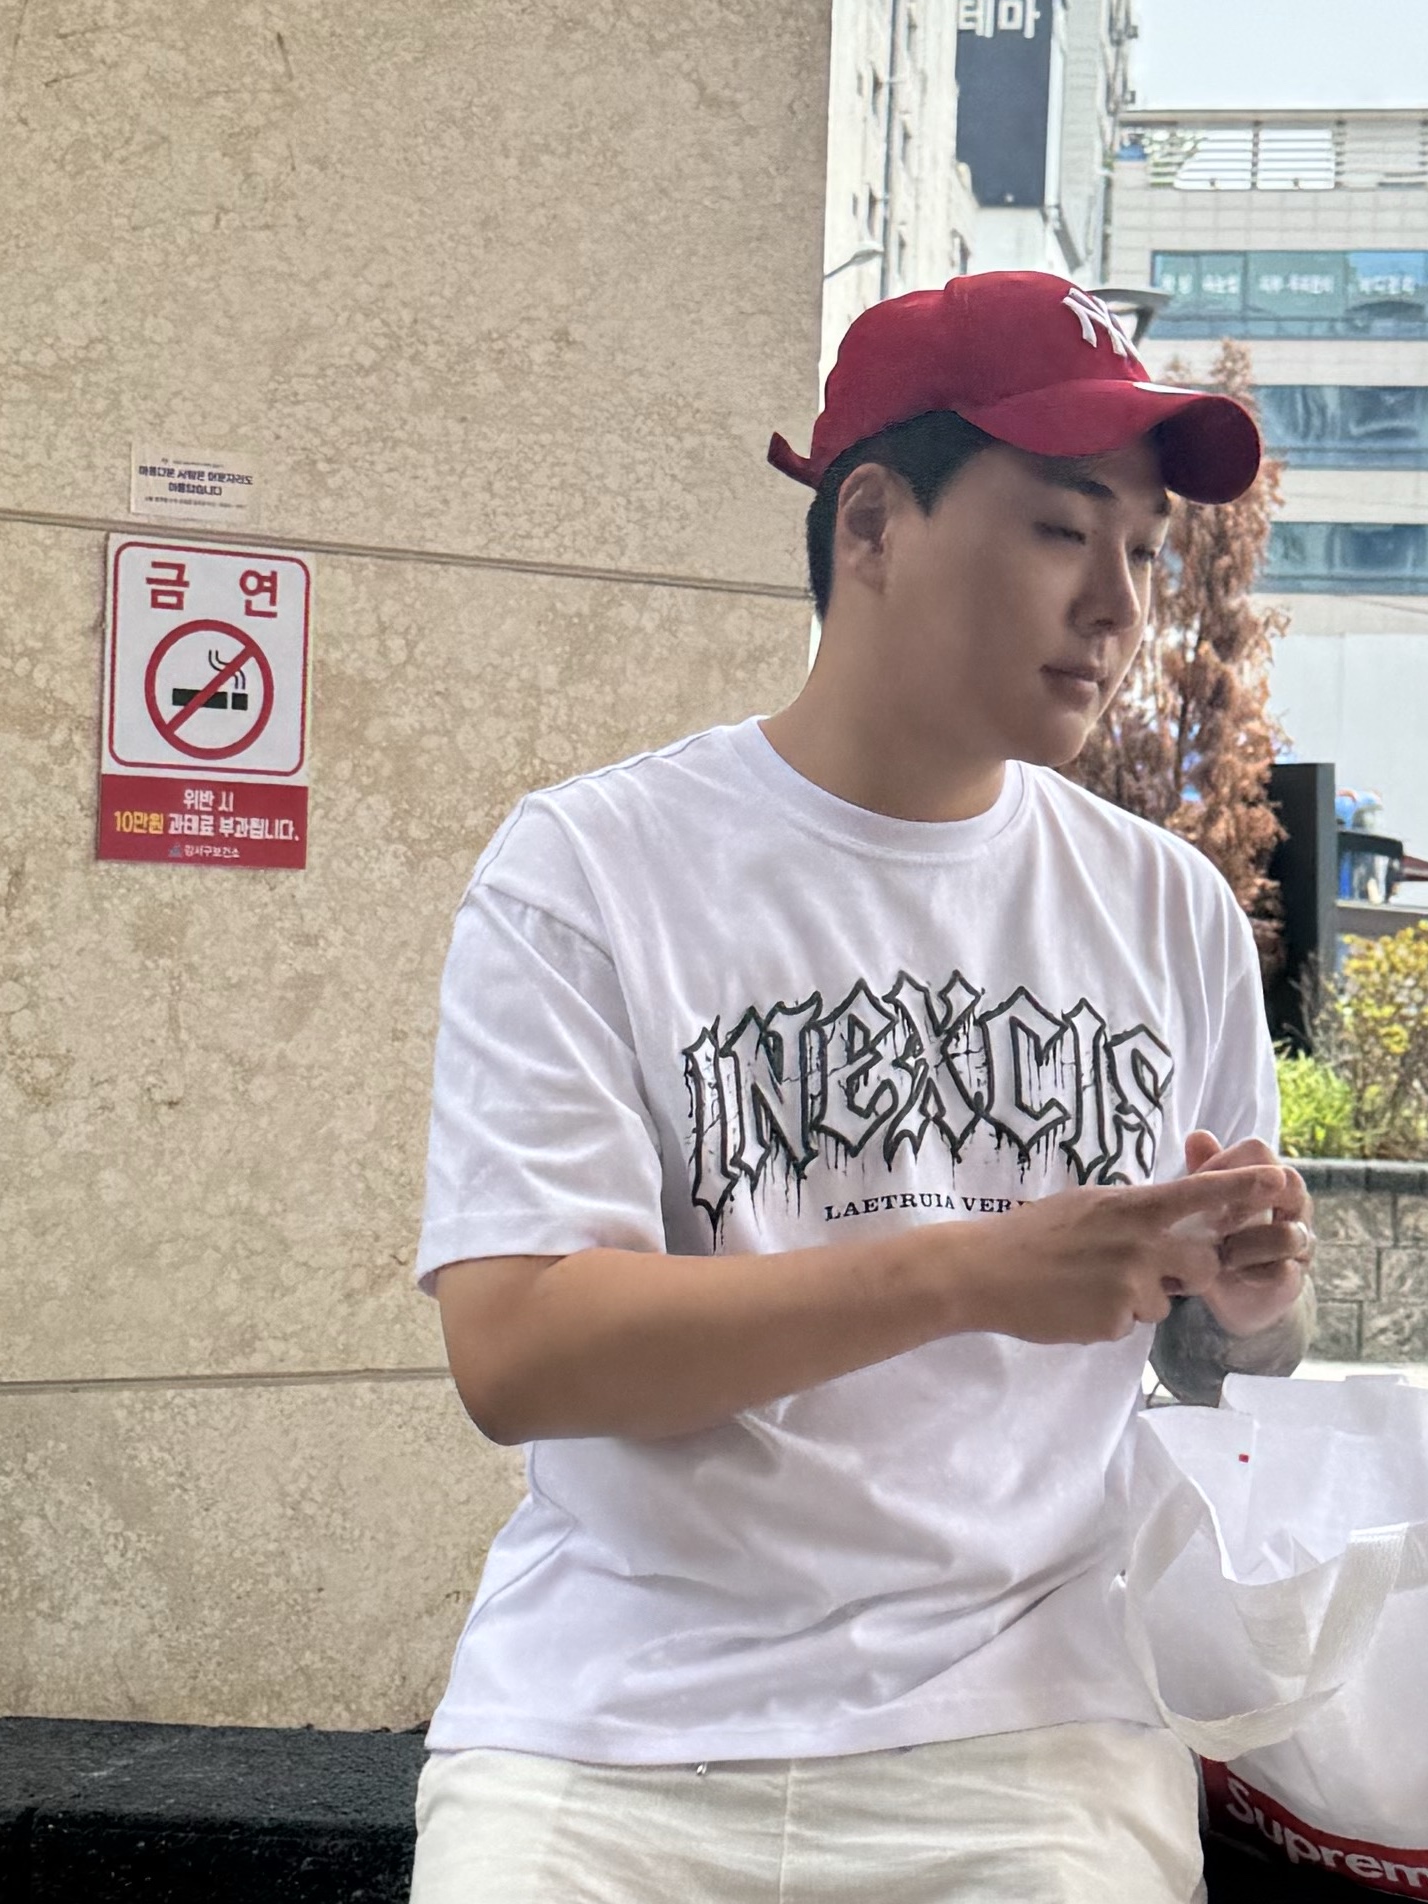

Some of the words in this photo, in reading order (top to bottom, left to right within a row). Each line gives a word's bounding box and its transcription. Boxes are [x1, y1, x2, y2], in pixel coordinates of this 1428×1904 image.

[145, 561, 190, 610] 금
[239, 569, 278, 618] 연
[183, 788, 215, 811] 위반
[218, 791, 234, 812] 시
[113, 810, 164, 835] 10만원
[168, 813, 215, 836] 과태료
[218, 816, 300, 841] 부과됩니다.
[184, 844, 240, 859] 강서구보건소
[824, 1193, 956, 1222] LAETRUIA
[961, 1196, 1031, 1213] VER
